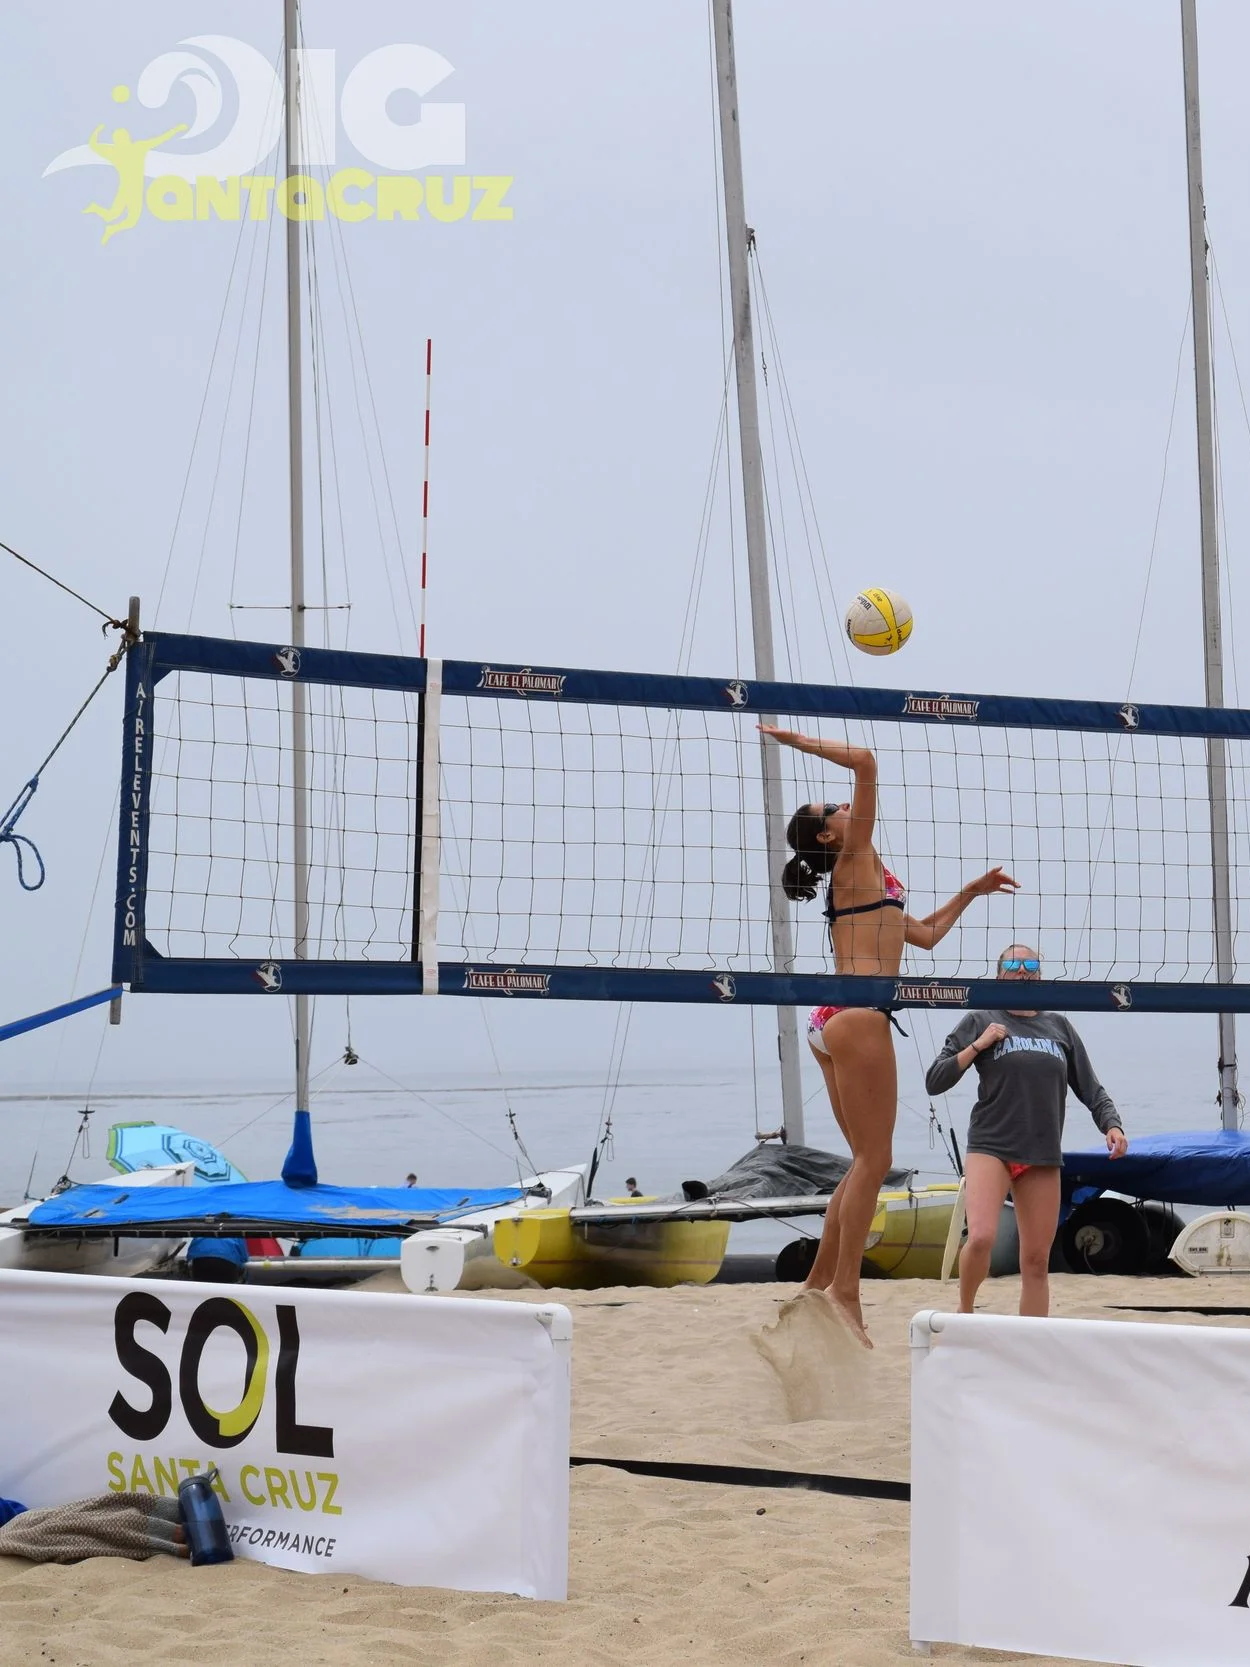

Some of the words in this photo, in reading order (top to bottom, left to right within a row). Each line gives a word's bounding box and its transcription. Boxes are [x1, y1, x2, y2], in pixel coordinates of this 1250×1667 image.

[489, 674, 509, 686] CAFE
[512, 675, 520, 687] EL
[522, 676, 556, 689] PALOMAR
[912, 700, 930, 712] CAFE
[932, 702, 941, 712] EL
[942, 702, 972, 714] PALOMAR
[123, 682, 146, 946] AIRELEVENTS.COM
[473, 975, 494, 986] CAFE
[497, 976, 506, 986] EL
[508, 976, 543, 988] PALOMAR
[902, 987, 921, 998] CAFE
[923, 988, 931, 999] EL
[932, 988, 963, 1000] PALOMAR
[993, 1036, 1064, 1062] CAROLINA
[108, 1291, 335, 1458] SOL
[239, 1464, 343, 1516] CRUZ
